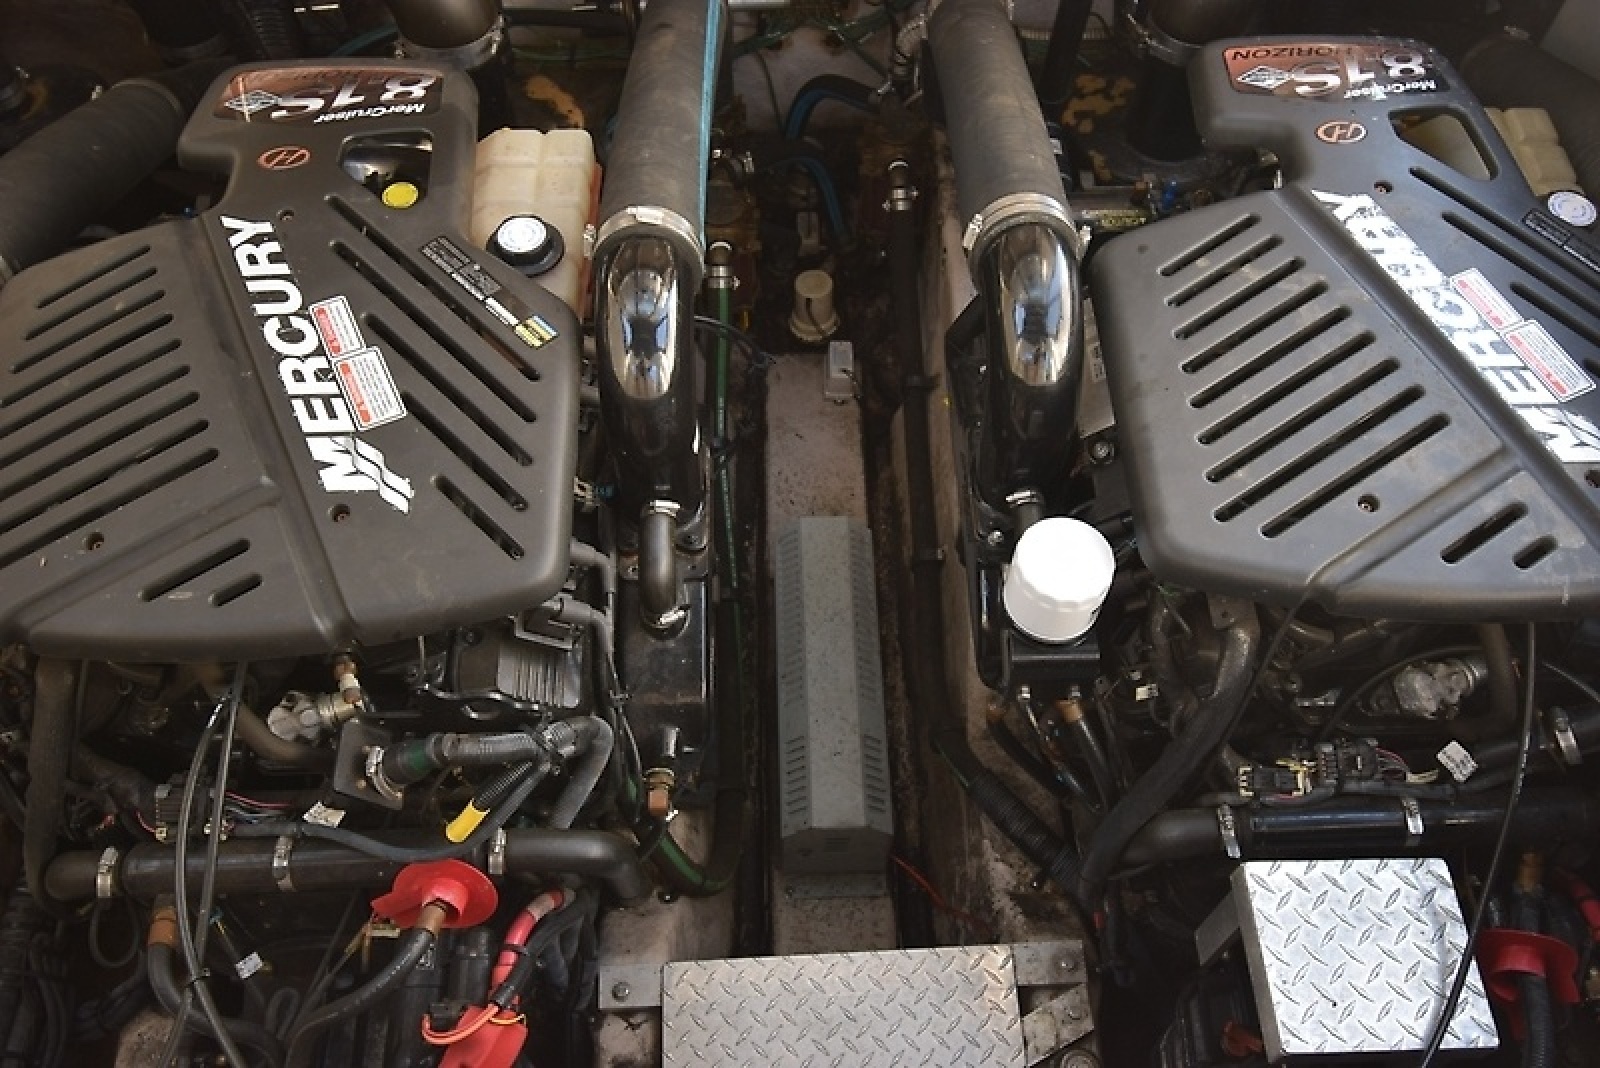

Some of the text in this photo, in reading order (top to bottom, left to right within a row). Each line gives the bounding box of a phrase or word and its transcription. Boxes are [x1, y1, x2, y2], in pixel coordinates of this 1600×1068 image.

[313, 103, 426, 124] MerCruiser
[220, 215, 384, 493] MERCURY
[1311, 190, 1600, 462] MERCURY
